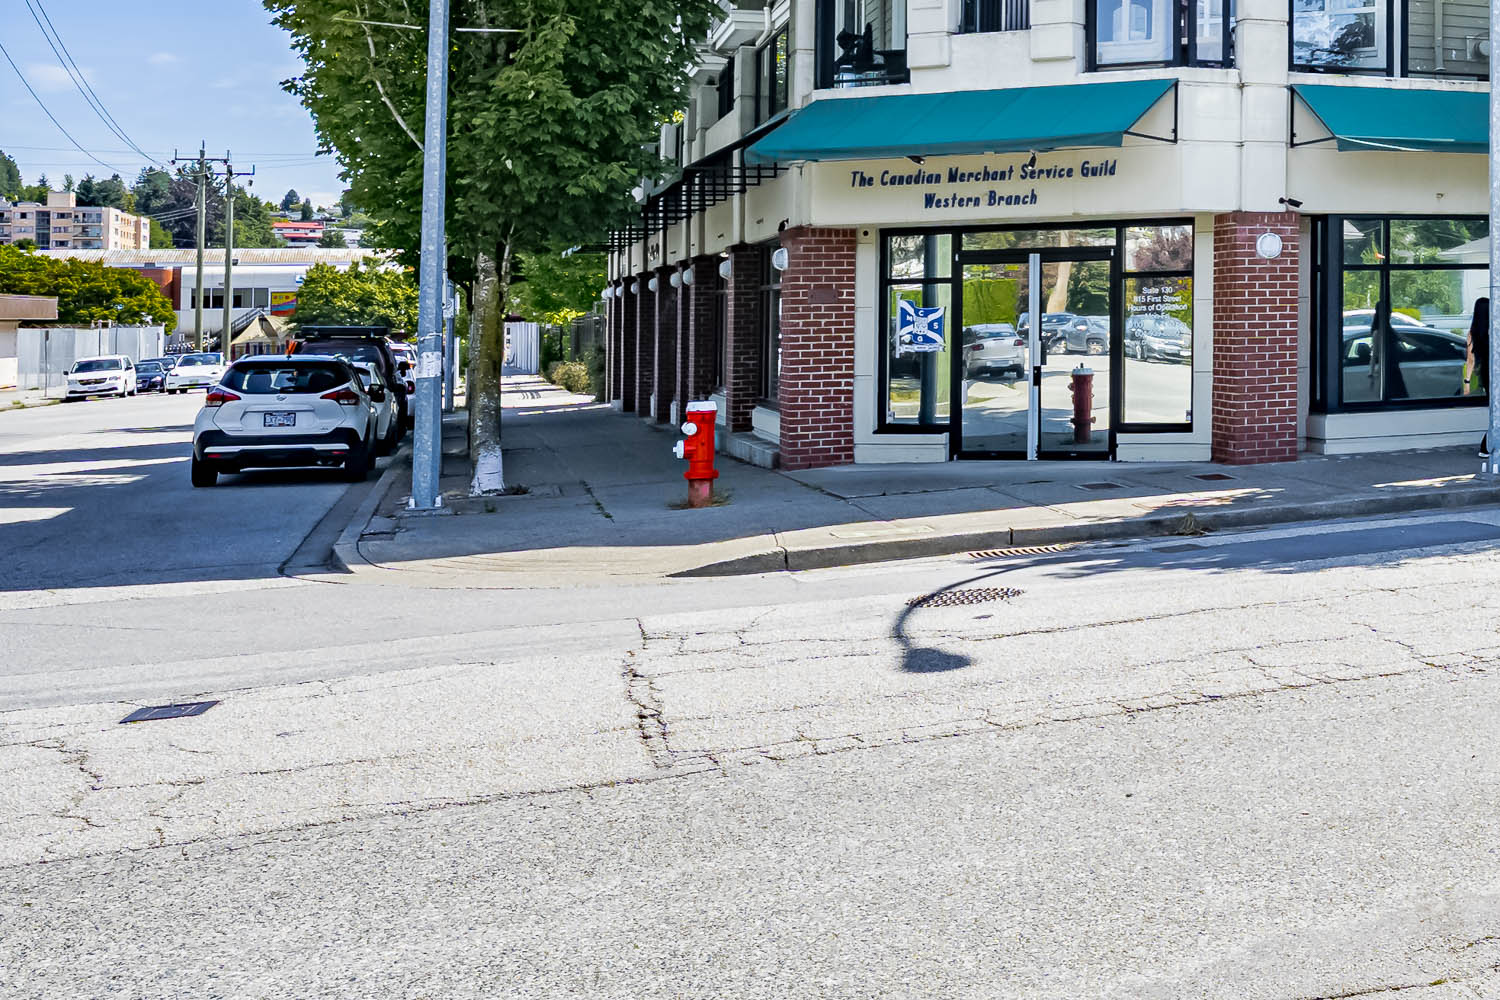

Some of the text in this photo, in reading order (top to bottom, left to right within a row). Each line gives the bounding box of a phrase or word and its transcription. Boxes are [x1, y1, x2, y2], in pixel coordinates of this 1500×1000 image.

[851, 159, 1117, 188] The Canadian Merchant Service Guild
[924, 188, 1038, 209] Western Branch
[918, 309, 925, 317] C
[933, 321, 939, 330] S
